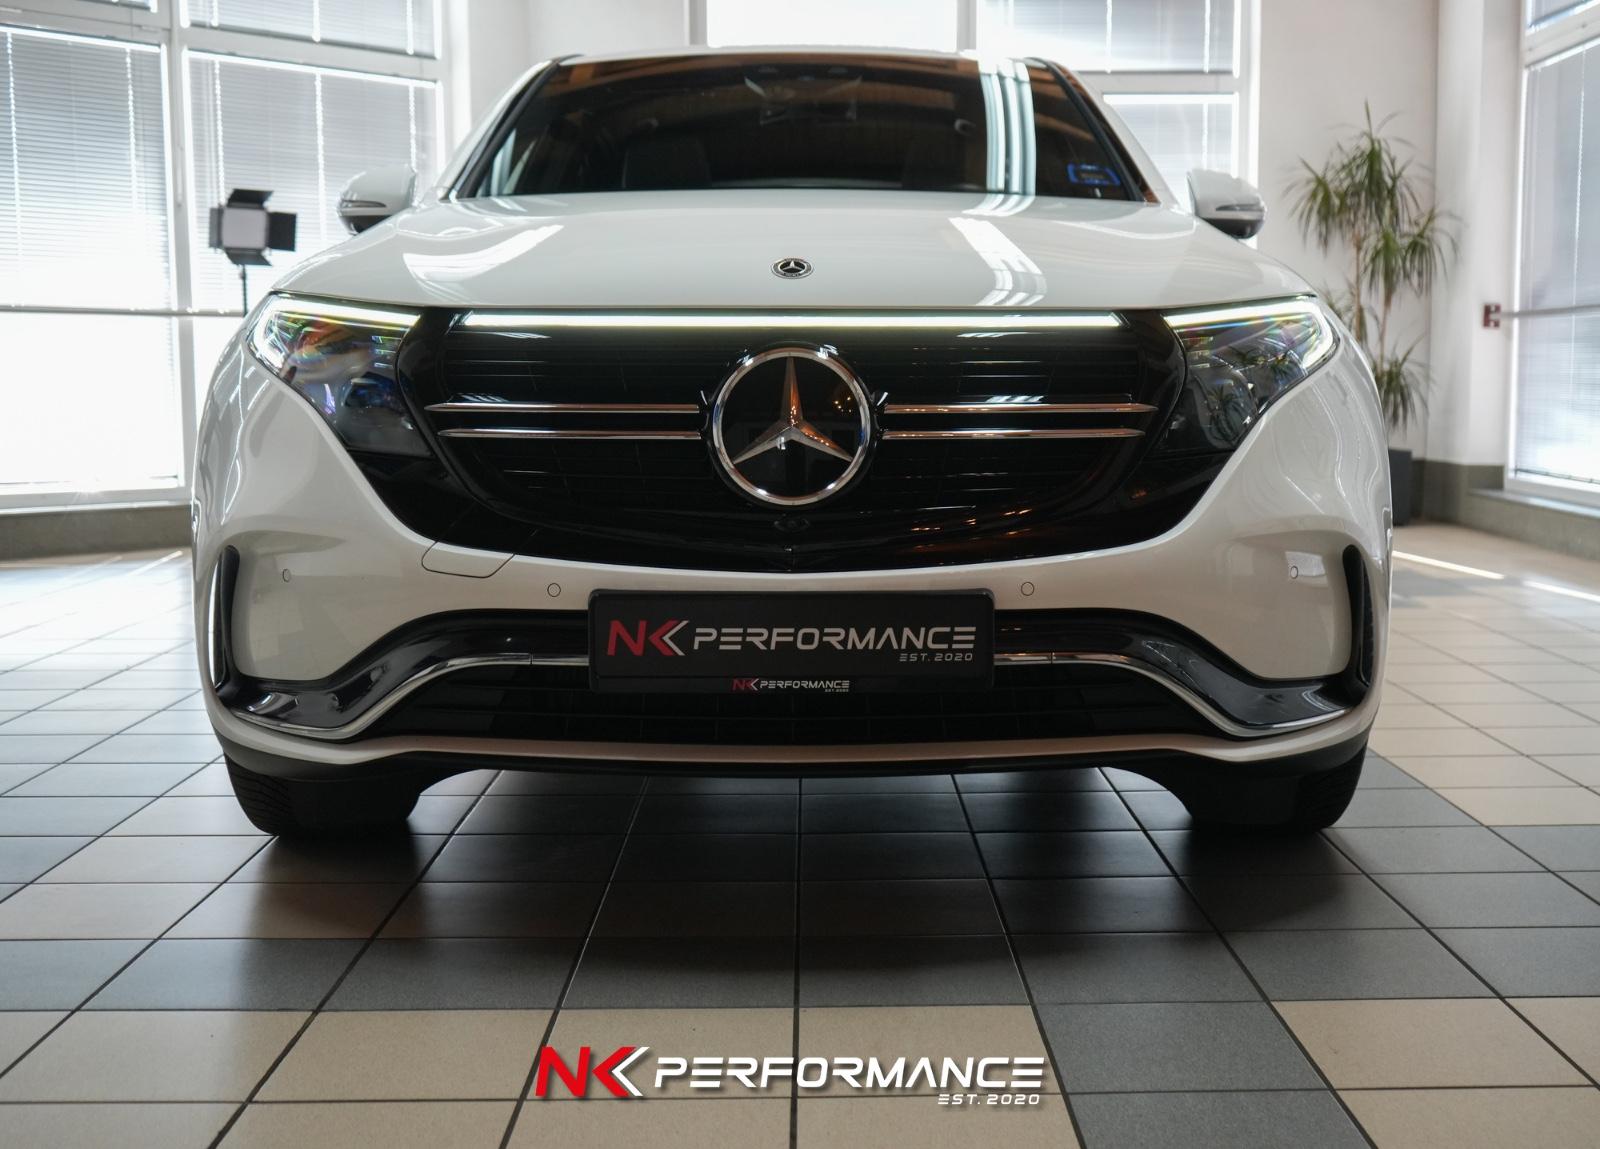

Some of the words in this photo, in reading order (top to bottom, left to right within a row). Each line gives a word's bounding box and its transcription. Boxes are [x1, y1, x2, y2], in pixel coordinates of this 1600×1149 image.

[693, 626, 976, 650] PERFORMANCE
[898, 653, 931, 662] EST.
[934, 653, 974, 662] 2020
[760, 680, 850, 689] PERFORMANCE
